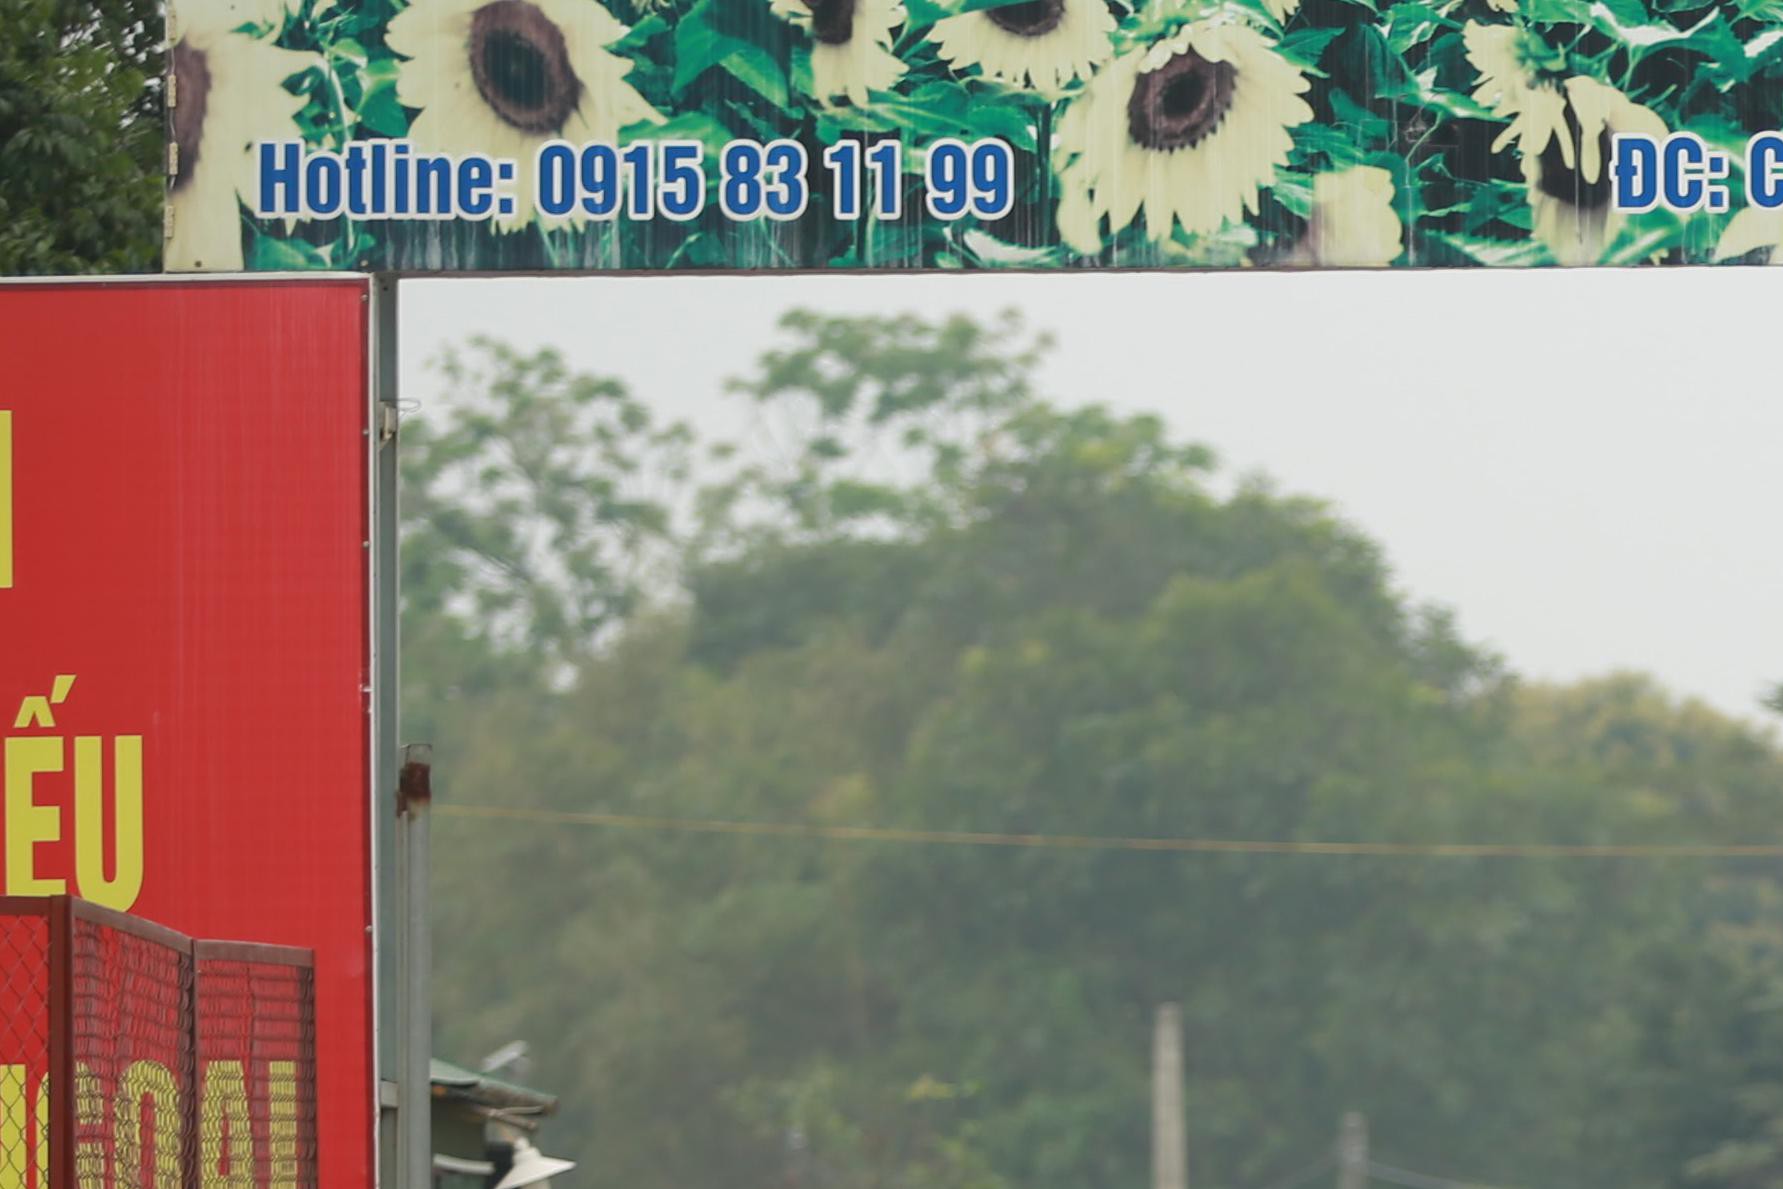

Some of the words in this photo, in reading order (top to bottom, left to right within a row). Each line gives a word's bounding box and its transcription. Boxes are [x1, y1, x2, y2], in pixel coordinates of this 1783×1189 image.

[258, 141, 514, 216] Hotline:
[537, 142, 702, 217] 0915
[722, 142, 808, 217] 83
[826, 143, 900, 217] 11
[928, 141, 1014, 217] 99
[1614, 135, 1726, 209] ĐC:
